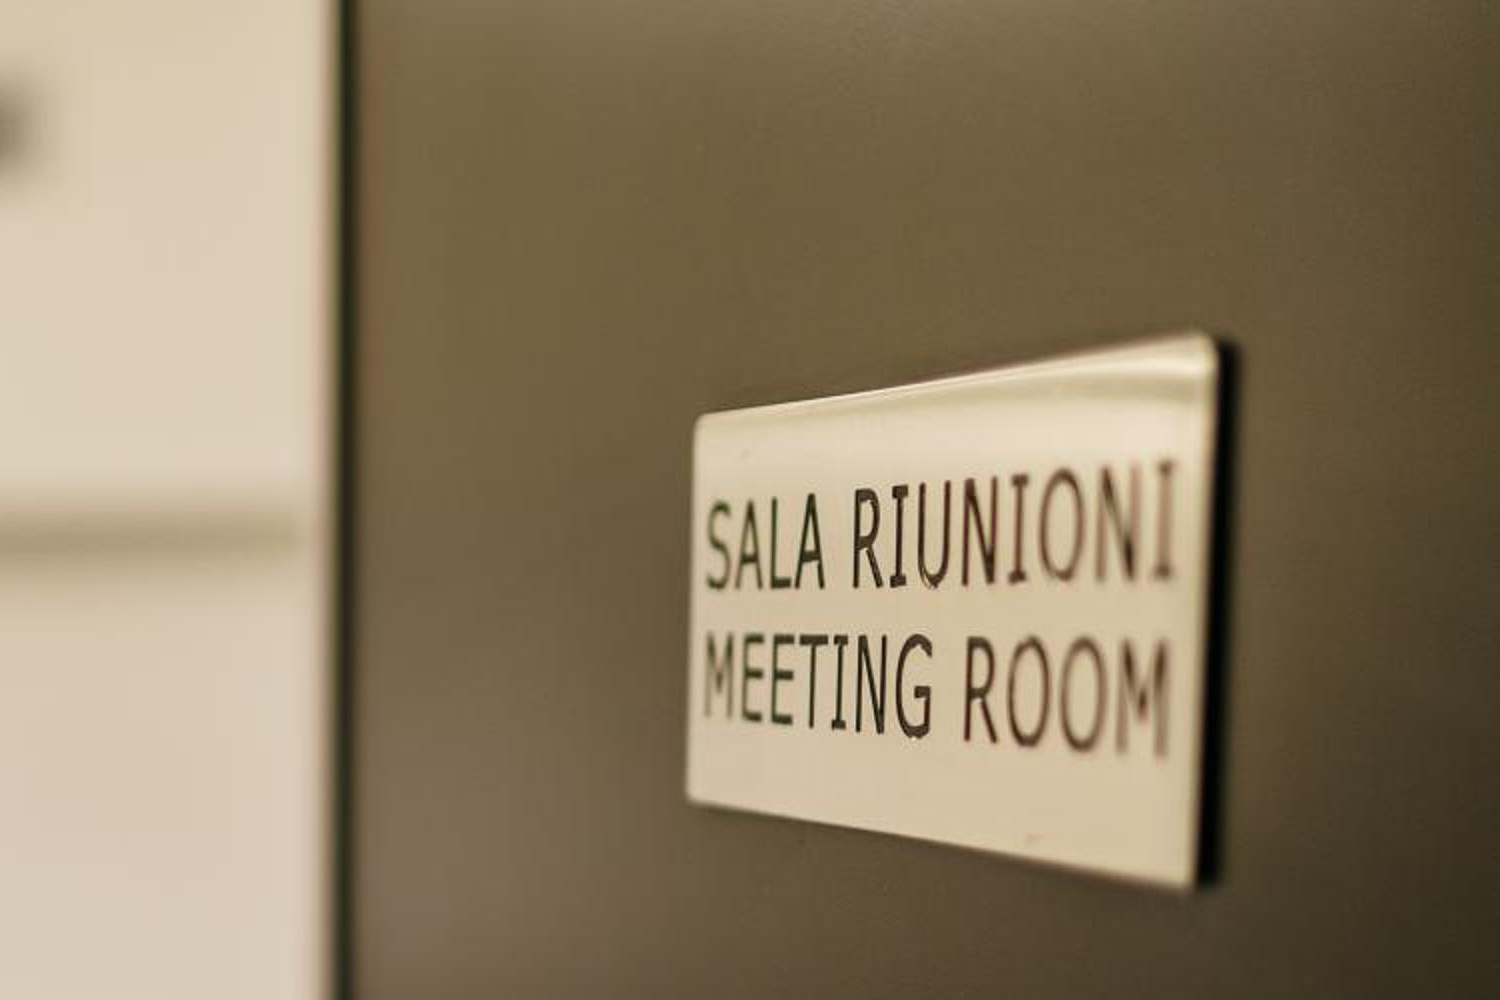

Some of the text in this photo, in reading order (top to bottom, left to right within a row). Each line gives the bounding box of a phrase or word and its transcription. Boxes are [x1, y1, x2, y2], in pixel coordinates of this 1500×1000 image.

[705, 458, 1177, 591] SALA RIUNIONI
[703, 631, 1171, 759] MEETING ROOM
